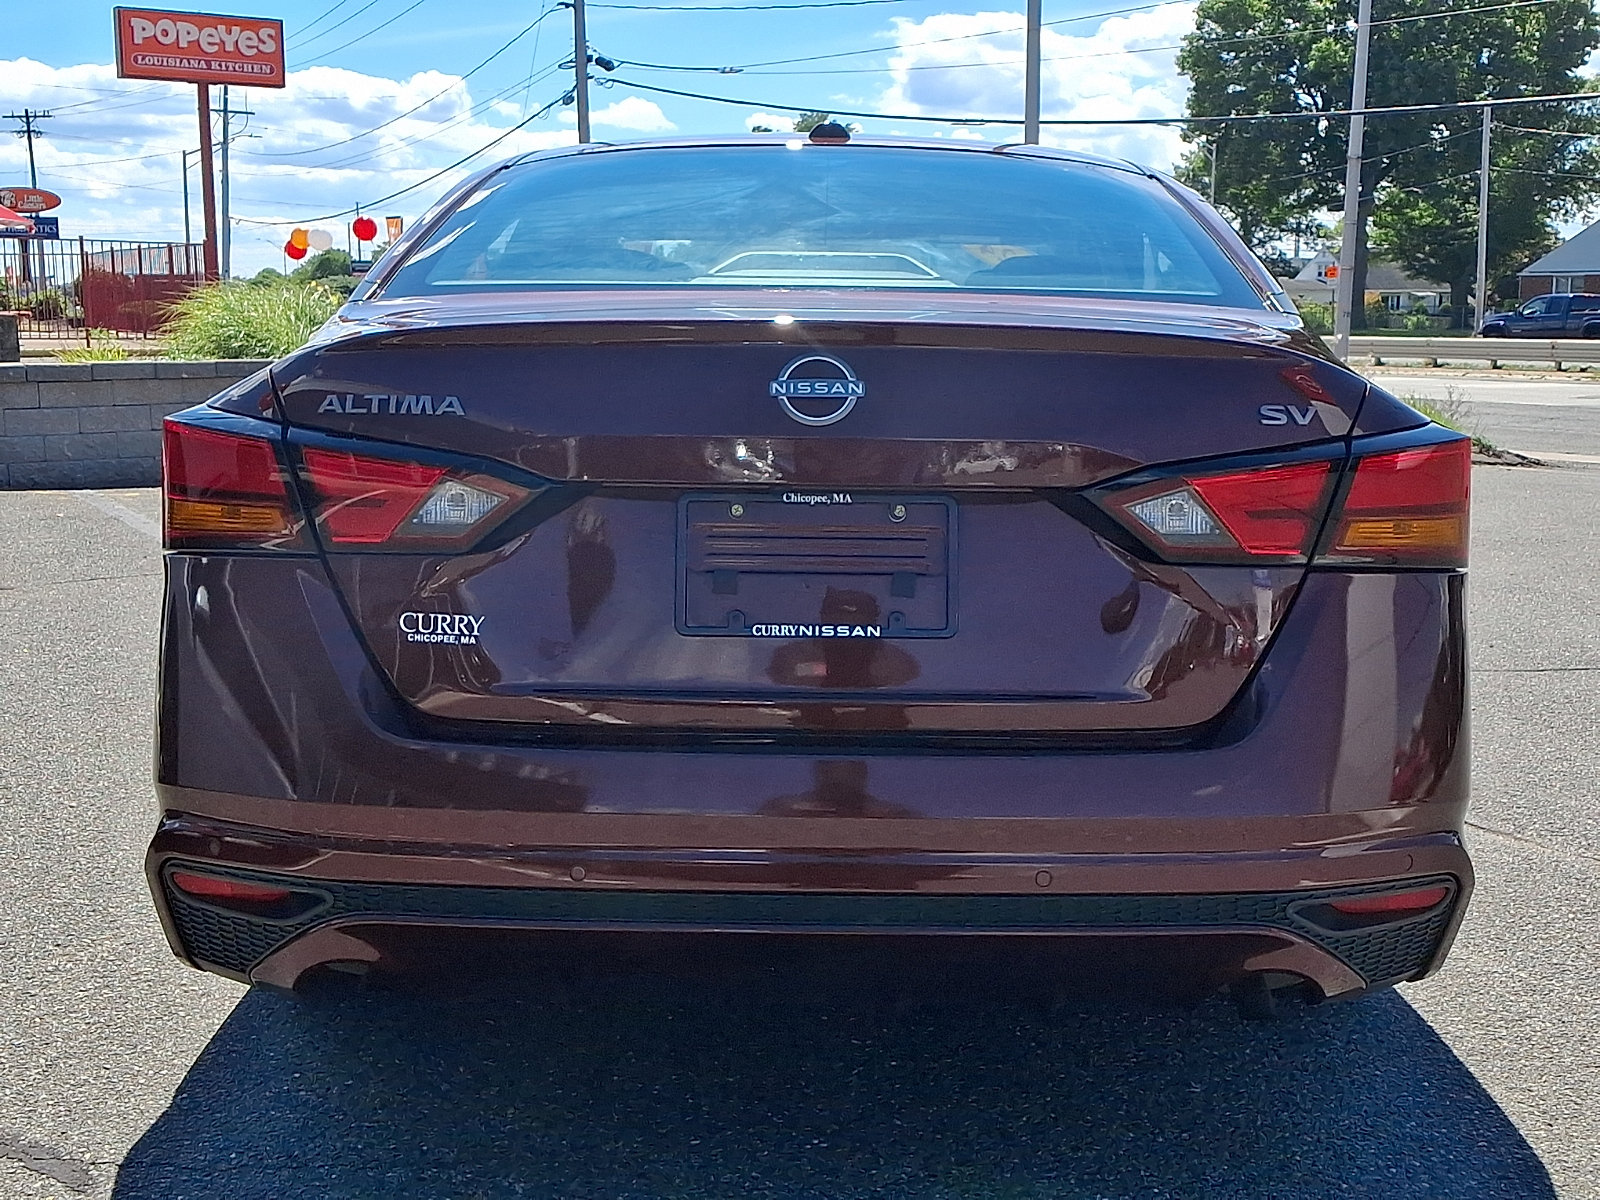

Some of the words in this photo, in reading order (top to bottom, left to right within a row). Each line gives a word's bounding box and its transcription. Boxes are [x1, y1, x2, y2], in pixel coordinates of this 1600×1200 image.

[136, 55, 207, 69] LOUISIANA
[211, 61, 271, 74] KITCHEN
[772, 382, 863, 394] NISSAN
[317, 394, 466, 416] ALTIMA
[1260, 404, 1317, 425] SV
[782, 492, 831, 505] Chicopee,
[832, 493, 853, 503] MA
[399, 612, 485, 635] CURRY
[407, 633, 459, 644] CHICOPEE,
[460, 635, 476, 644] MA
